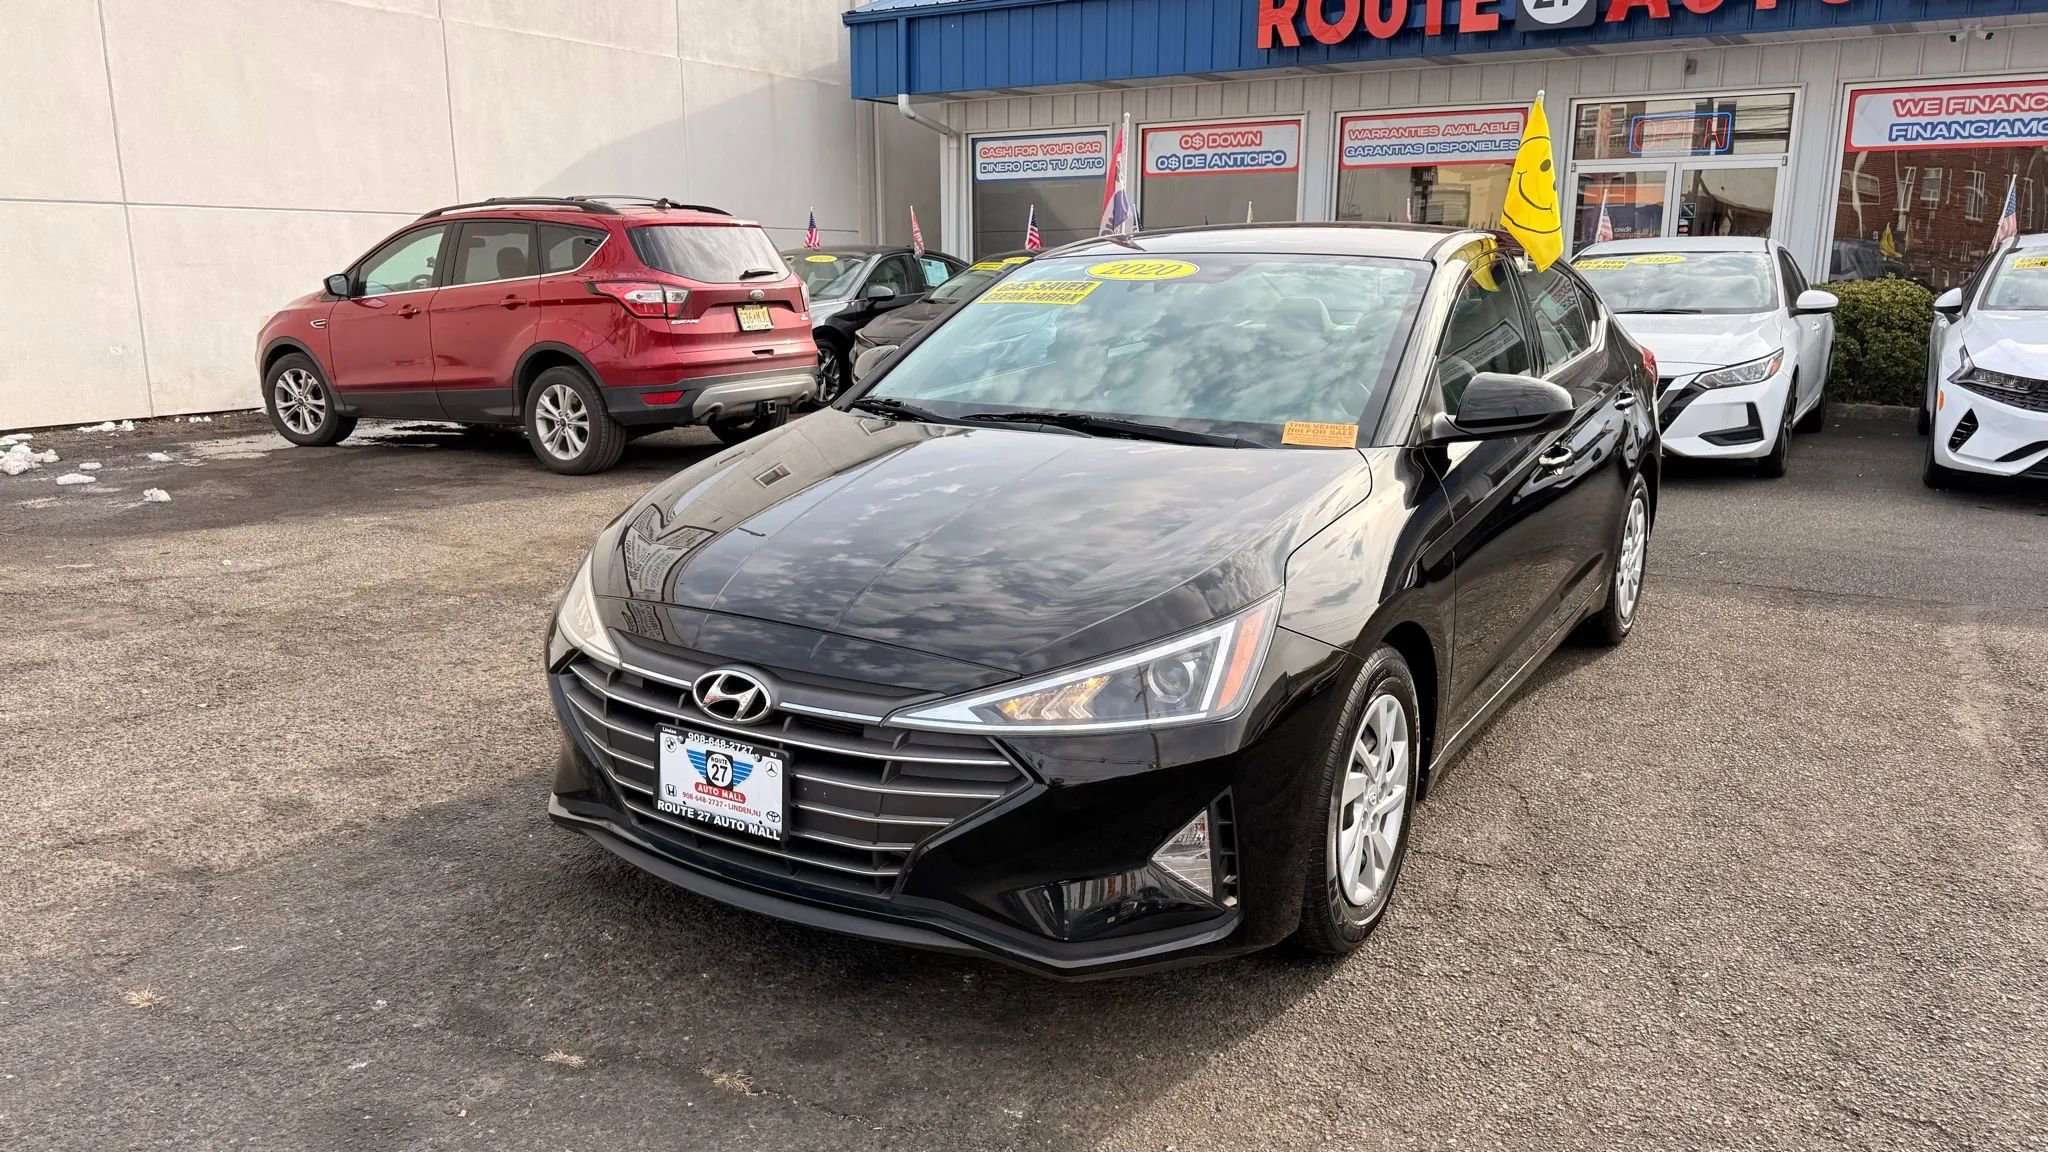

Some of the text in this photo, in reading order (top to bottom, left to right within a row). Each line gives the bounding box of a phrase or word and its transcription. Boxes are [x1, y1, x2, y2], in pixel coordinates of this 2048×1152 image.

[1893, 98, 1943, 117] WE
[1207, 131, 1262, 148] DOWN
[1349, 122, 1520, 141] WARRANTIES AVAILABLE
[1634, 117, 1728, 150] OPEN
[980, 142, 1101, 158] CASH FOR YOUR CAR
[1344, 139, 1521, 157] GARANTIAS DISPONIBLES
[980, 157, 1105, 173] DINERO POR TU AUTO
[1183, 153, 1206, 169] DE
[1208, 150, 1287, 168] ANTICIPO
[1103, 263, 1183, 276] 2020
[688, 732, 753, 754] 908-648-2727
[710, 756, 728, 765] ROUTE
[711, 763, 728, 783] 27
[697, 785, 744, 802] AUTO MALL
[657, 800, 780, 841] ROUTE 27 AUTO MALL
